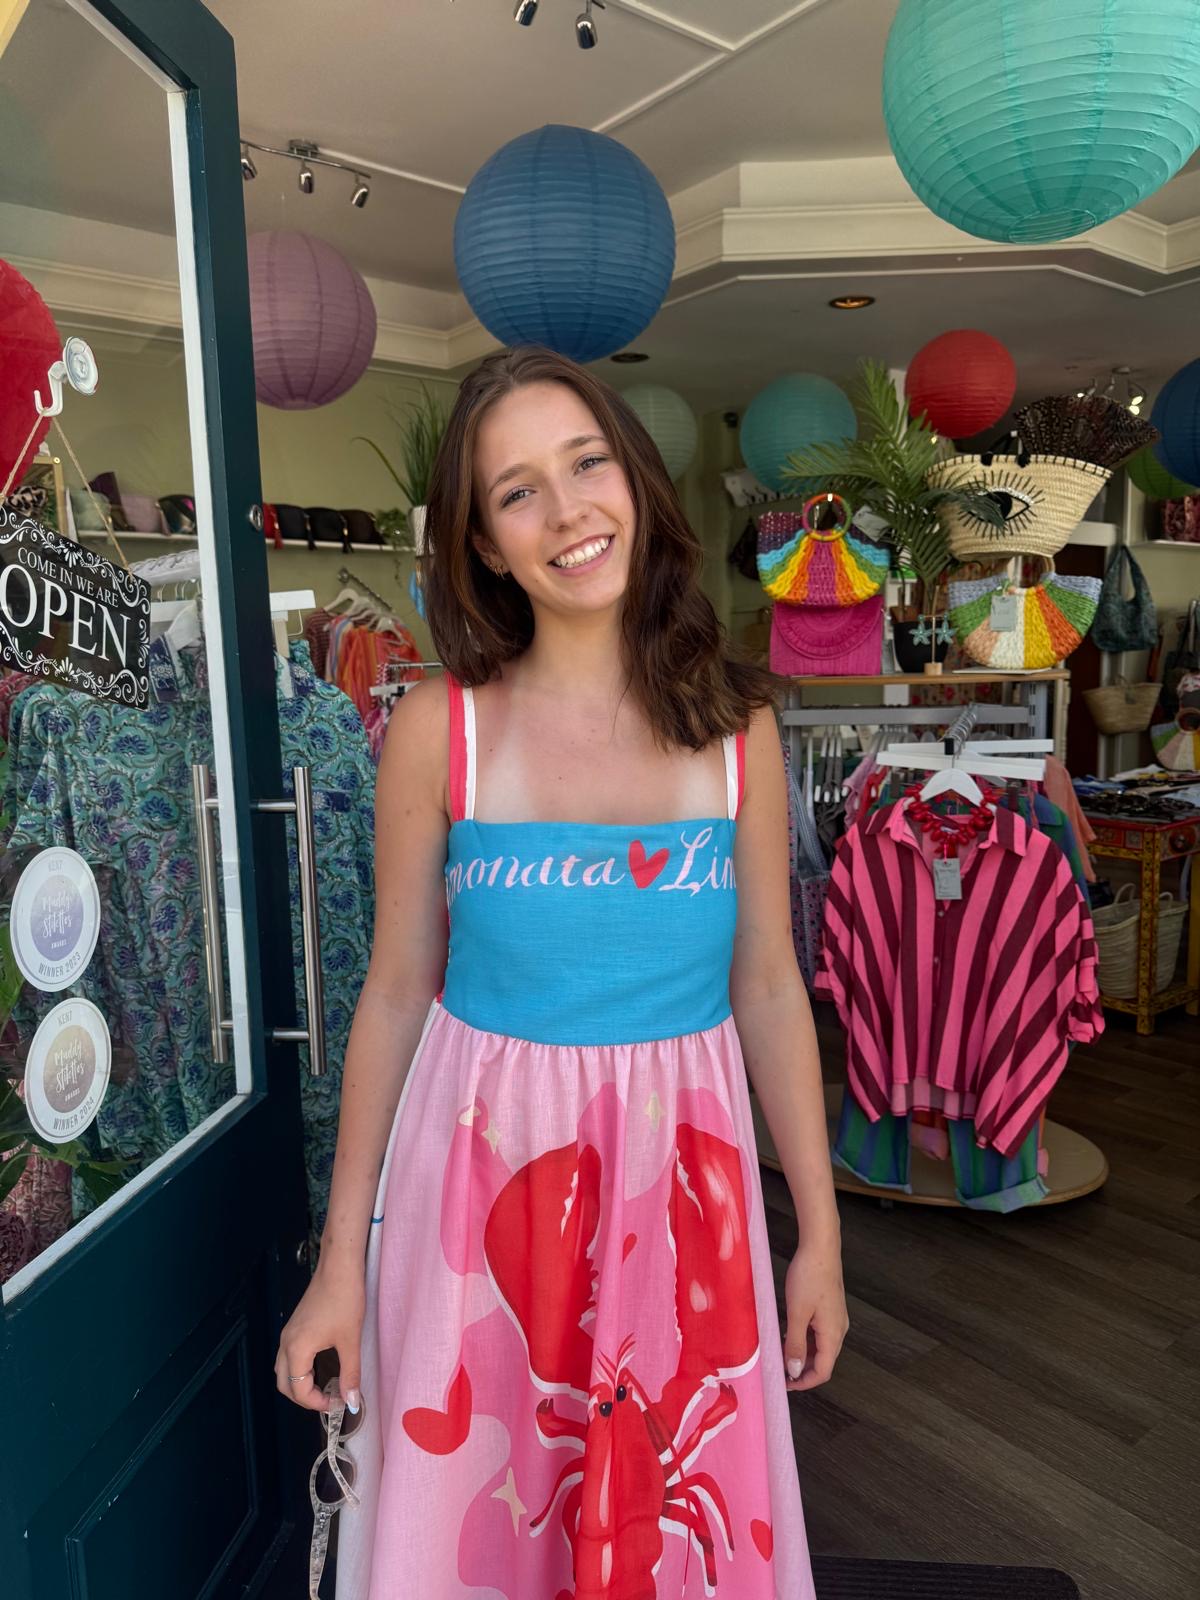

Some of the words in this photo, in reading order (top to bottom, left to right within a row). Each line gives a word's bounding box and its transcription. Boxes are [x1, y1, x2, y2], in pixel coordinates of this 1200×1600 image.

[17, 547, 57, 579] COME
[59, 568, 73, 587] IN
[76, 576, 95, 596] WE
[96, 588, 120, 608] ARE
[0, 563, 132, 668] OPEN
[38, 963, 64, 978] WINNER
[65, 951, 82, 973] 2023
[57, 1010, 73, 1026] KENT
[53, 1116, 79, 1130] WINNER
[79, 1096, 95, 1120] 2024
